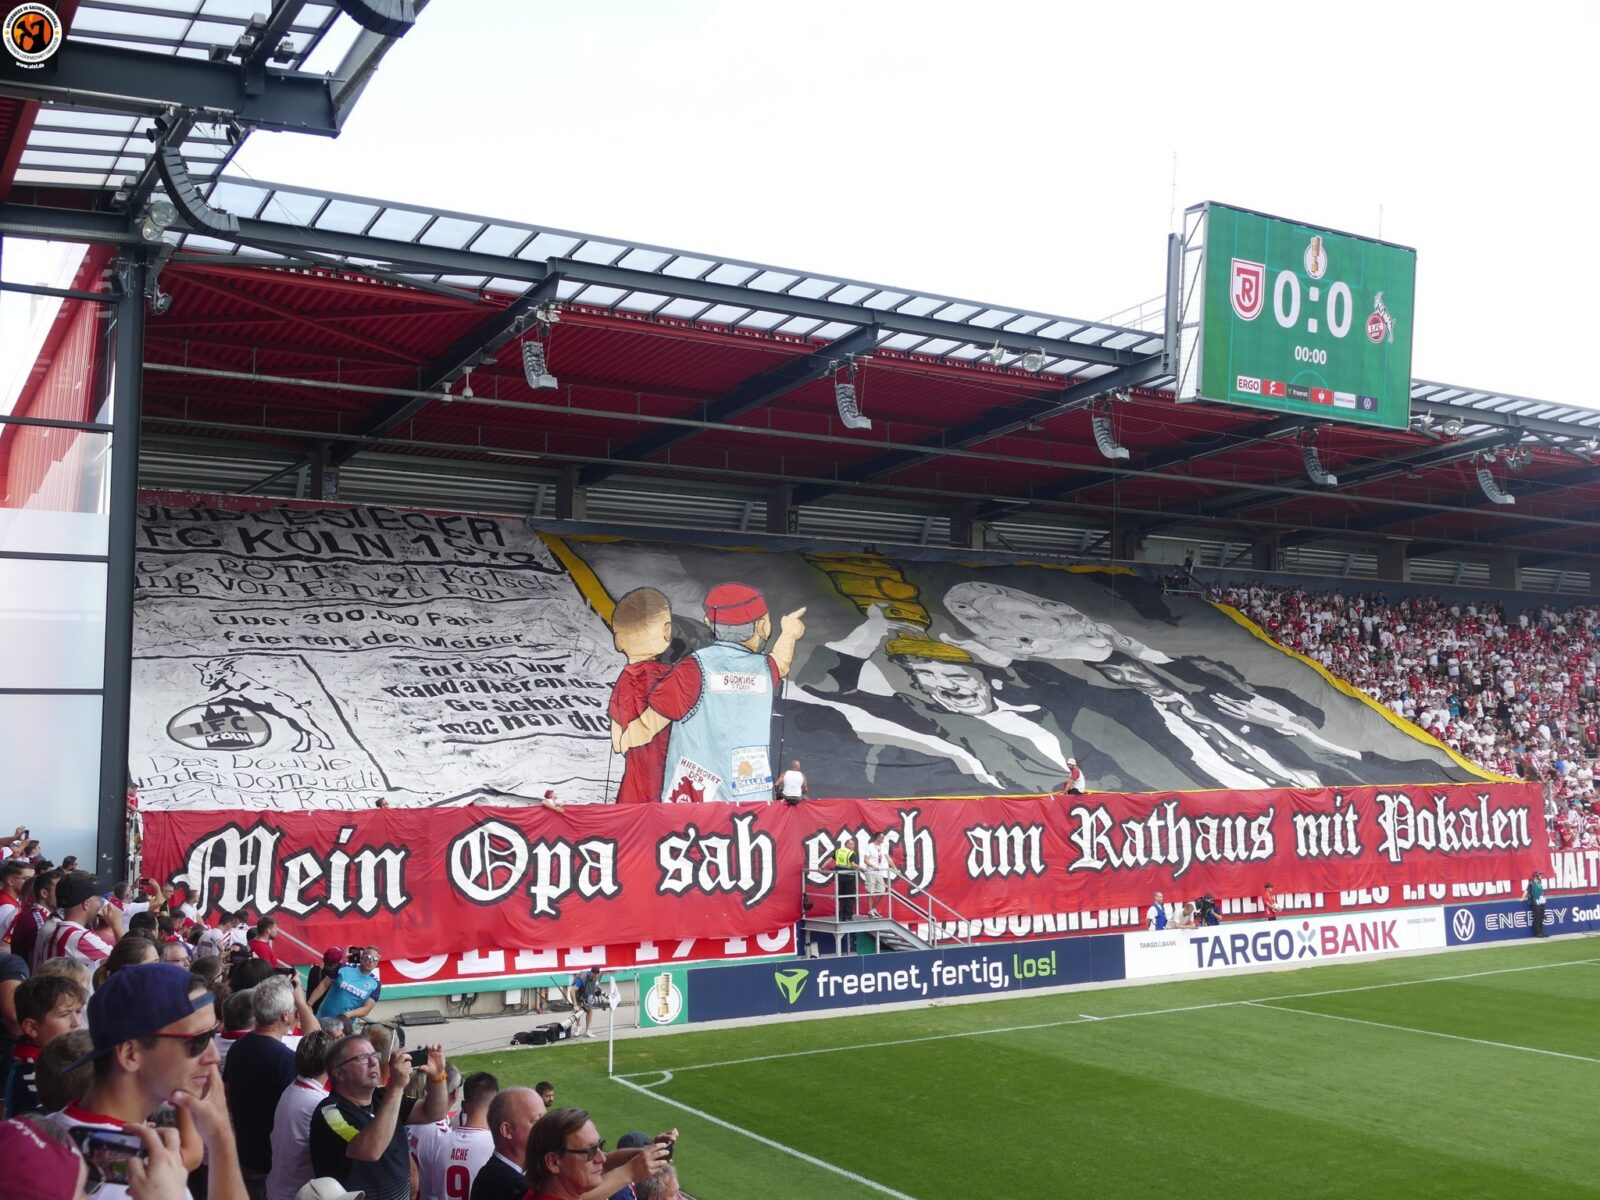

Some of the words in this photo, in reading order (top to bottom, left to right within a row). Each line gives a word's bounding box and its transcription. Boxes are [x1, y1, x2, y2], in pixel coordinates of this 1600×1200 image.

[1274, 270, 1352, 338] 0:0
[1294, 345, 1327, 365] 00:00
[1238, 379, 1260, 391] ERGO
[237, 526, 394, 558] KÖLN
[364, 566, 426, 583] voll
[213, 614, 290, 626] Über
[567, 710, 611, 733] dic
[205, 732, 252, 744] KÖLN
[150, 755, 218, 773] Das
[232, 754, 352, 771] Double
[171, 821, 408, 917] Mein
[449, 819, 622, 917] Opa
[658, 812, 775, 907] sah
[965, 824, 1046, 879] am
[1068, 801, 1276, 879] Rathaus
[1292, 795, 1362, 857] mit
[1376, 793, 1532, 863] Pokalen
[817, 964, 928, 997] freenet,
[932, 956, 1009, 988] fertig,
[1014, 950, 1057, 979] los!
[340, 980, 368, 1000] REWE
[450, 1148, 469, 1161] ACHE
[446, 1164, 471, 1200] 9
